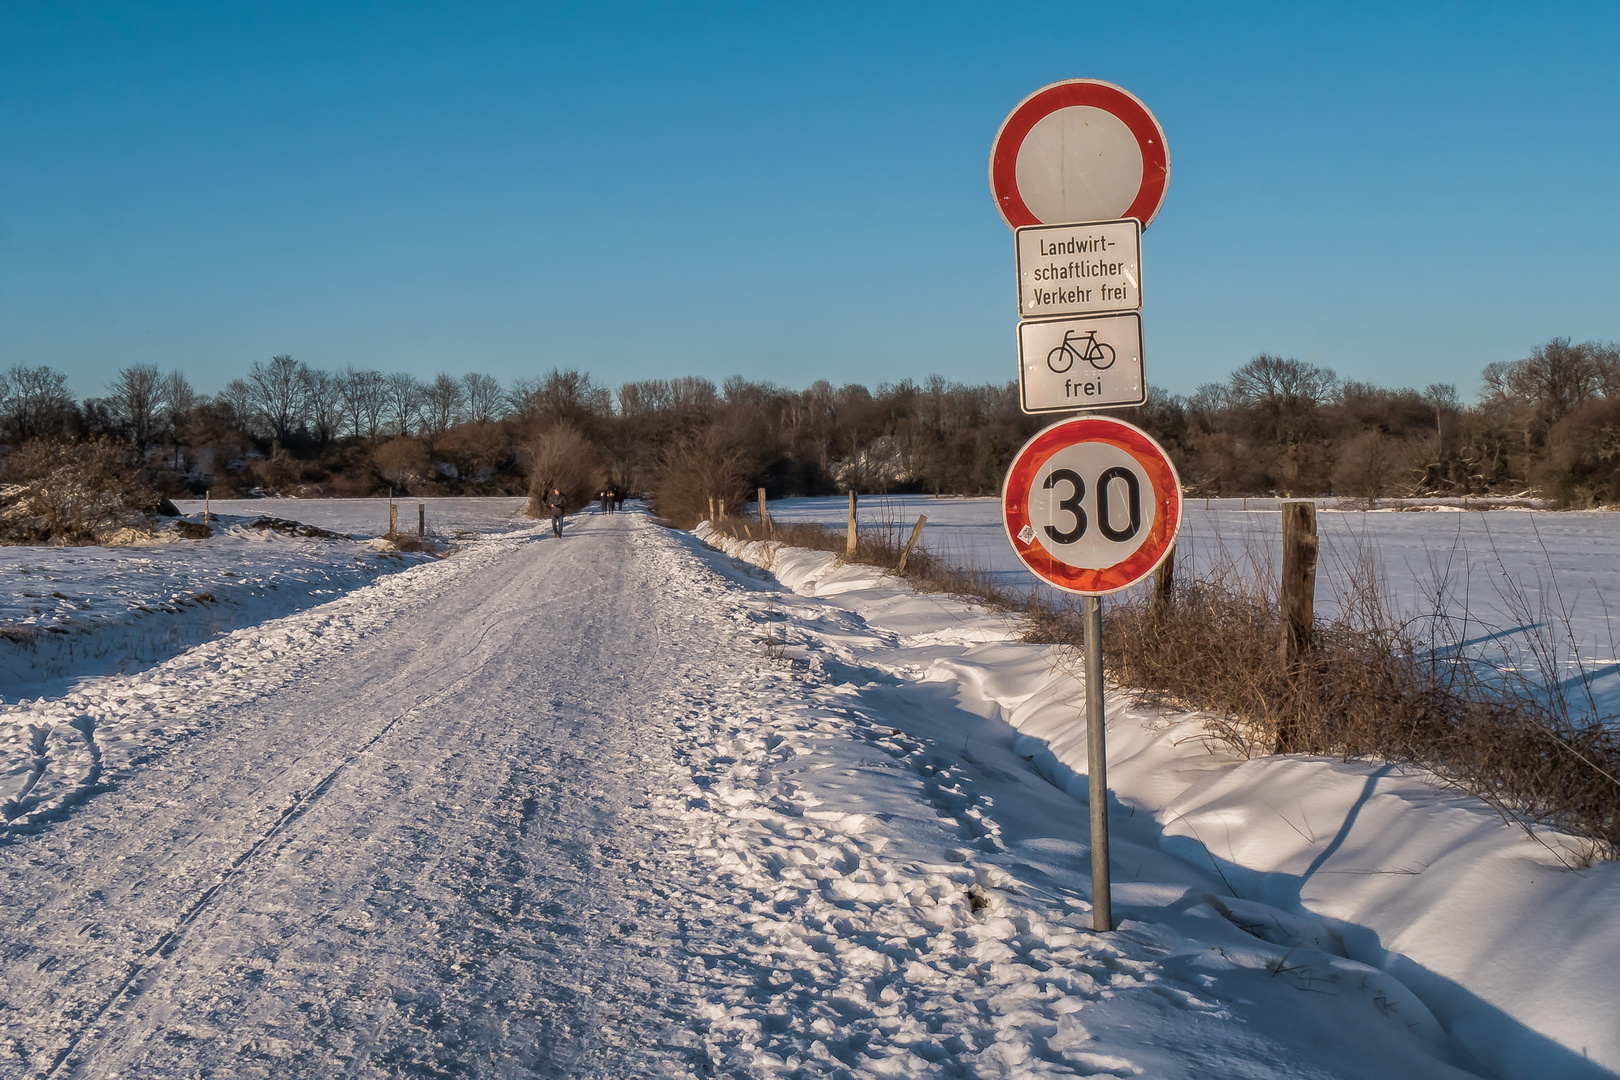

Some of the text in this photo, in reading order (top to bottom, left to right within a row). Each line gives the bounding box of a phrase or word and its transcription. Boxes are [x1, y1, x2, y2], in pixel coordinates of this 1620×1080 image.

[1040, 236, 1115, 256] Landwirt-
[1034, 260, 1123, 280] schaftlicher
[1034, 283, 1126, 305] Verkehr frei
[1065, 377, 1102, 397] frei
[1043, 466, 1141, 544] 30
